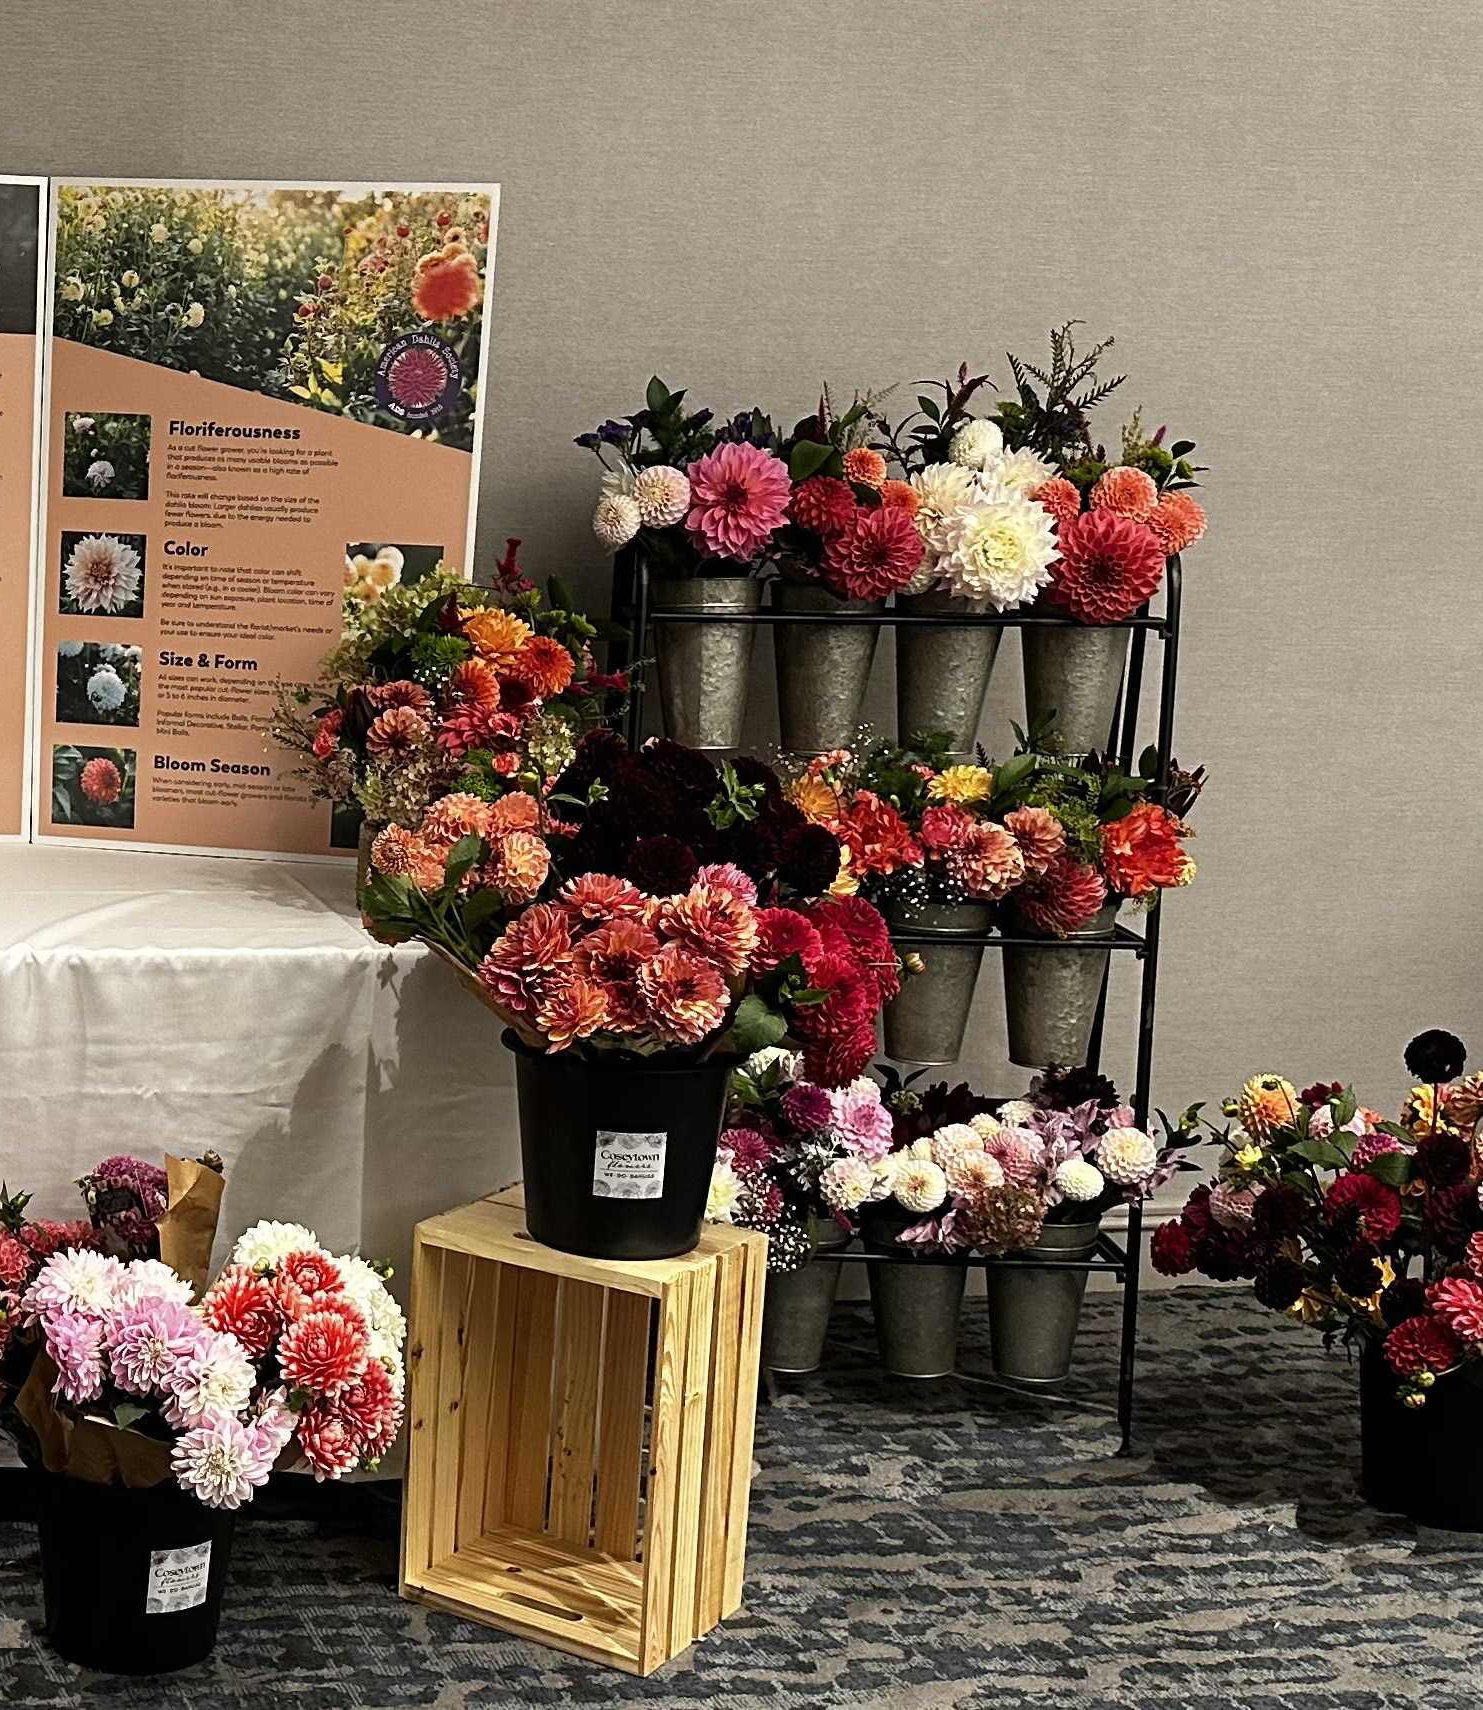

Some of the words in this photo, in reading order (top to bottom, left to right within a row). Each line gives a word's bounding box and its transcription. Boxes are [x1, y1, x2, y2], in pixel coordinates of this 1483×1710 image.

[442, 347, 459, 379] Society
[169, 421, 300, 439] Floriferousness
[163, 540, 208, 557] Color
[159, 652, 192, 668] Size
[197, 653, 209, 669] &
[214, 654, 258, 671] Form
[153, 755, 206, 772] Bloom
[210, 759, 270, 776] Season
[601, 1150, 660, 1163] Coseytown
[155, 1562, 205, 1577] Coseytown
